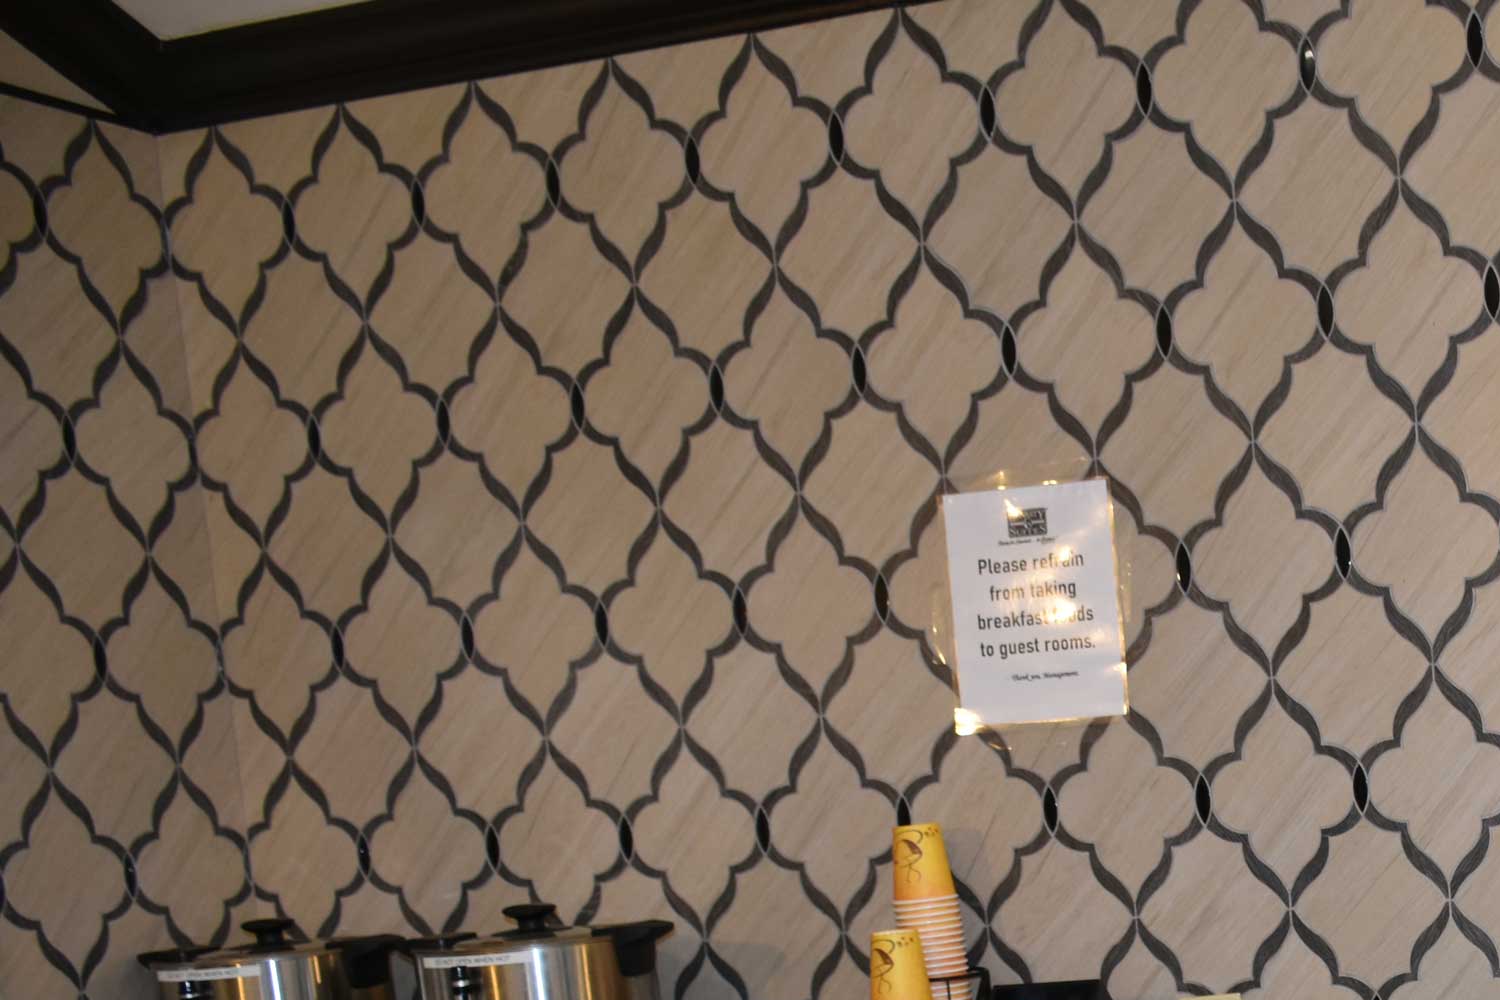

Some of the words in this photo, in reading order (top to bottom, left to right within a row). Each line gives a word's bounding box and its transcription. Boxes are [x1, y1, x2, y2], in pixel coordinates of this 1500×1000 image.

[977, 557, 1027, 575] Please
[990, 586, 1024, 601] from
[1030, 580, 1076, 599] taking
[977, 609, 1049, 630] breakfast
[980, 642, 995, 657] to
[1000, 638, 1040, 659] guest
[1045, 635, 1096, 653] rooms.
